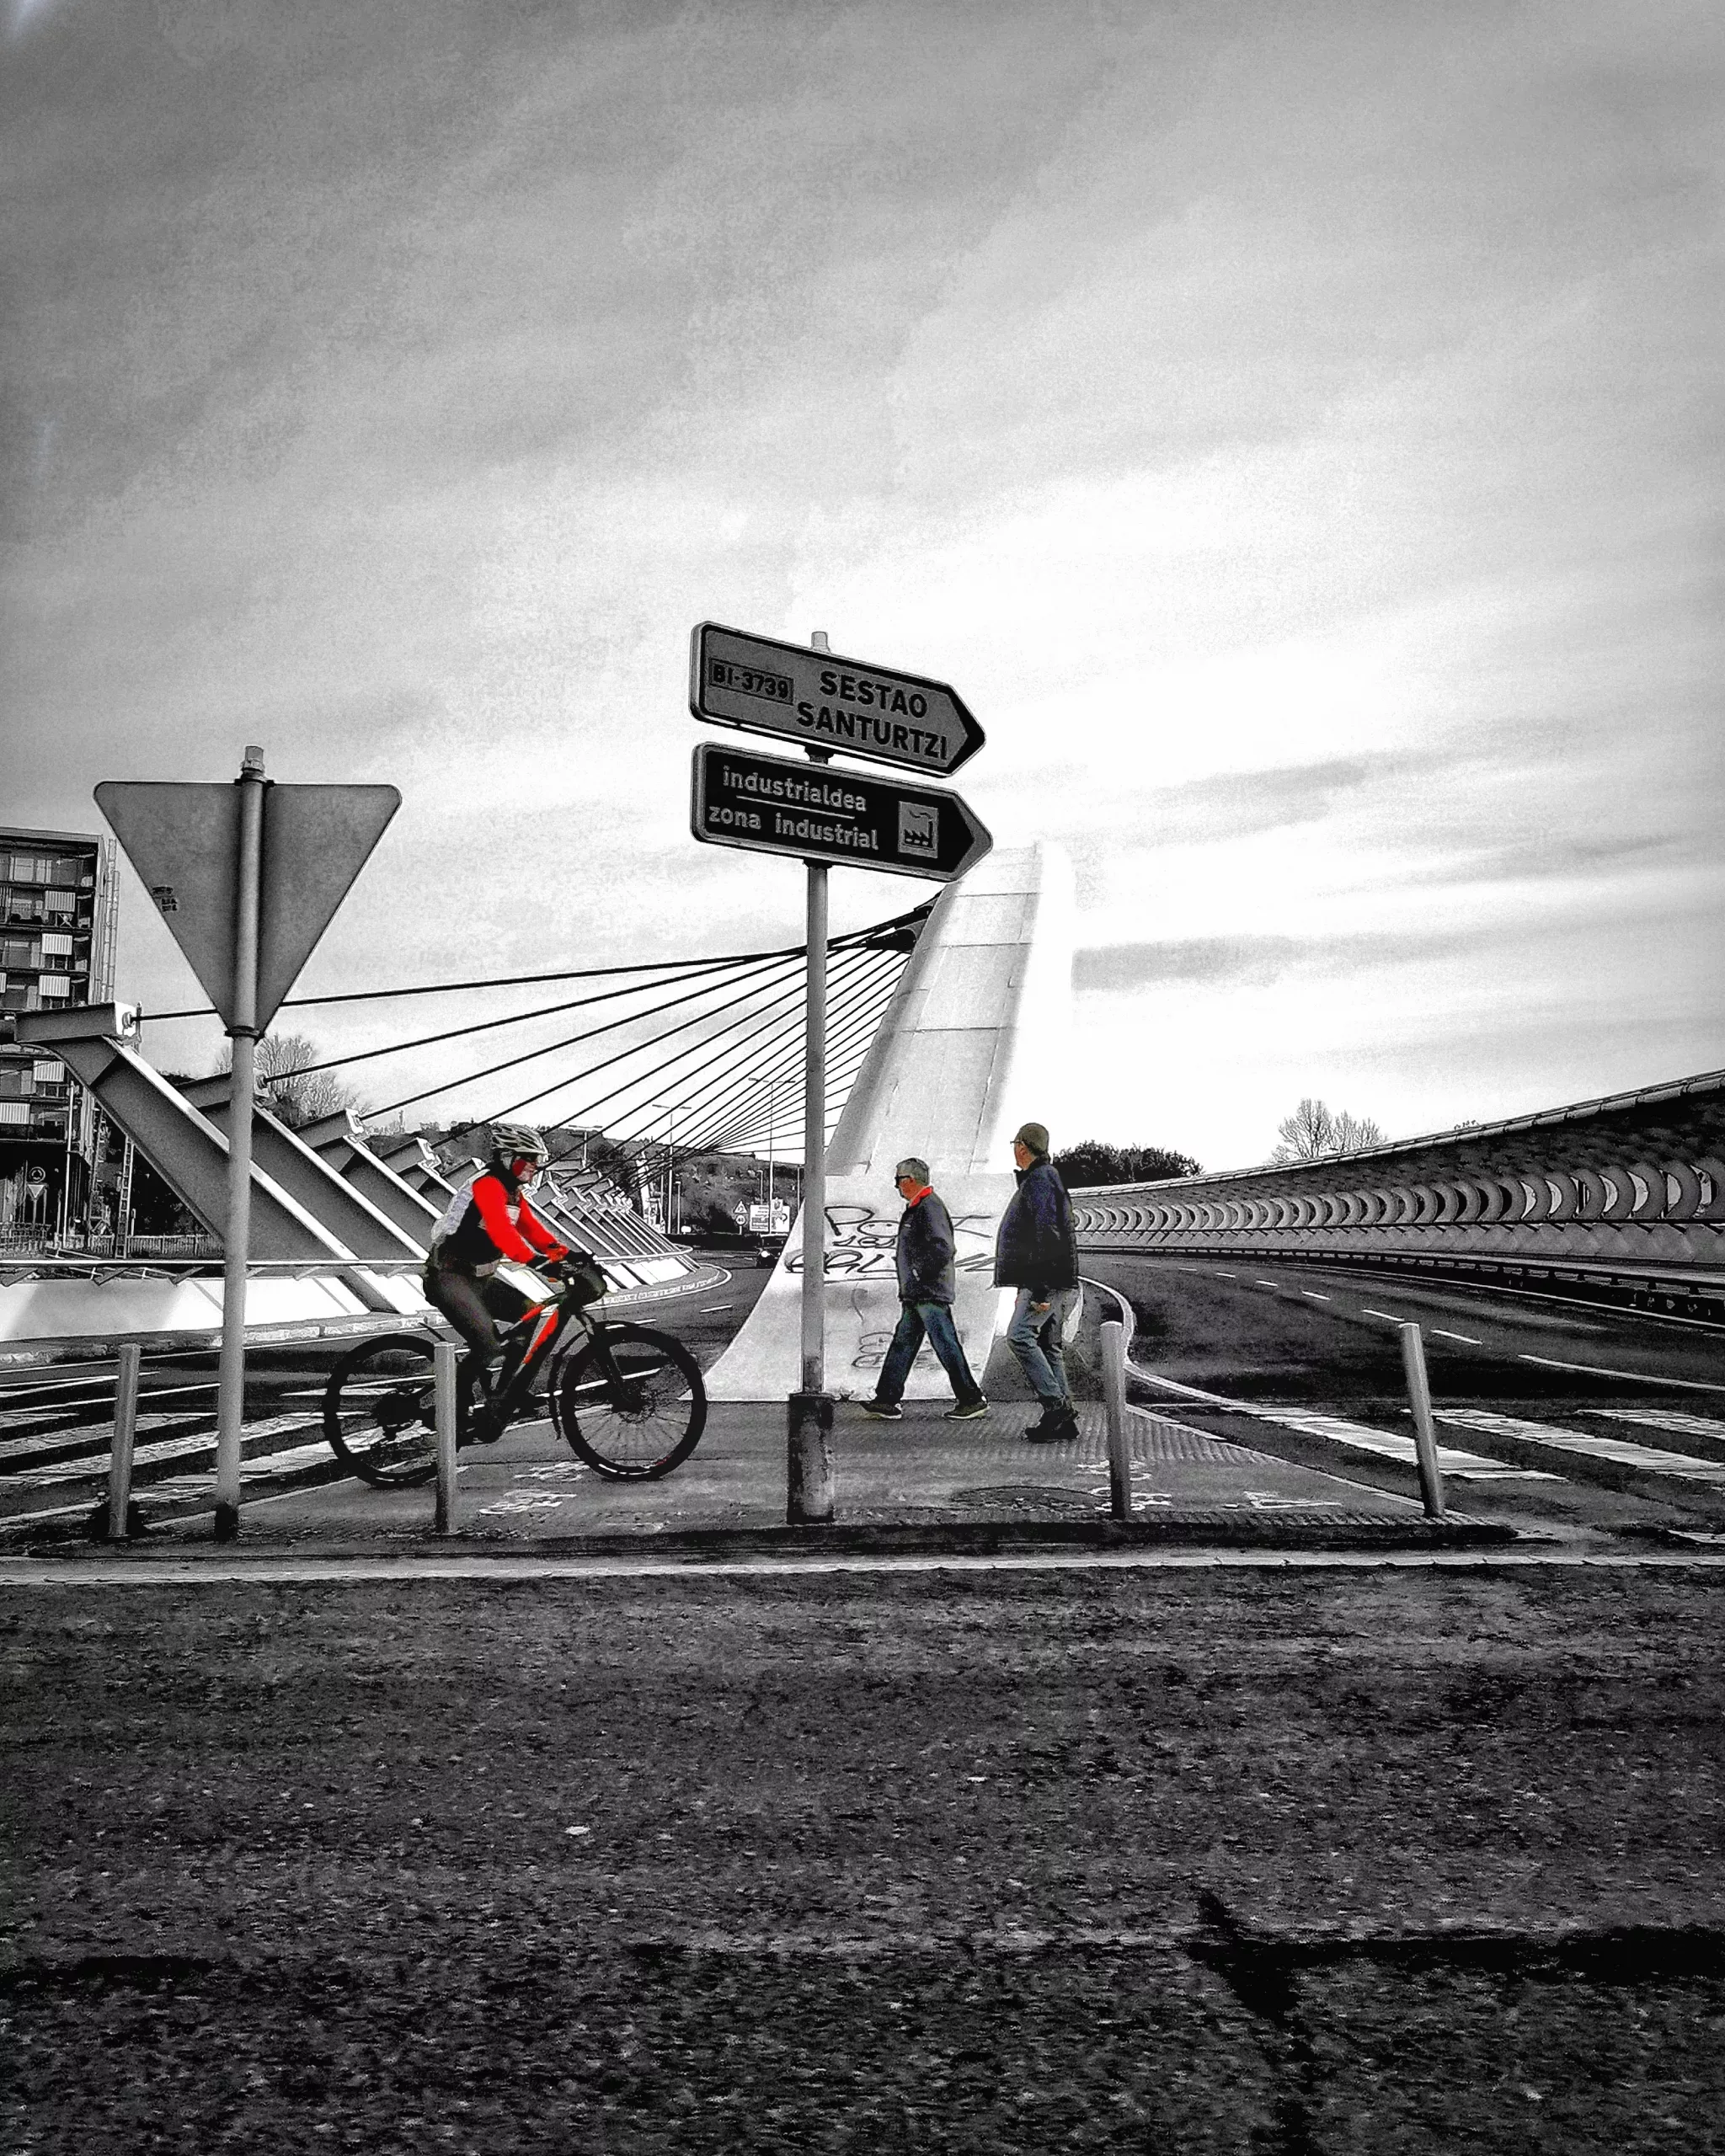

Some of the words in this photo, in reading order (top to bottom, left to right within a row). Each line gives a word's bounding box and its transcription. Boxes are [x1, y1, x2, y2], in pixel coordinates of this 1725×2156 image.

[713, 664, 788, 698] BI-3739
[820, 671, 927, 718] SESTAO
[797, 702, 947, 760] SANTURTZI
[723, 766, 867, 812] industrialdea
[708, 805, 761, 830] zona
[775, 812, 879, 851] industrial
